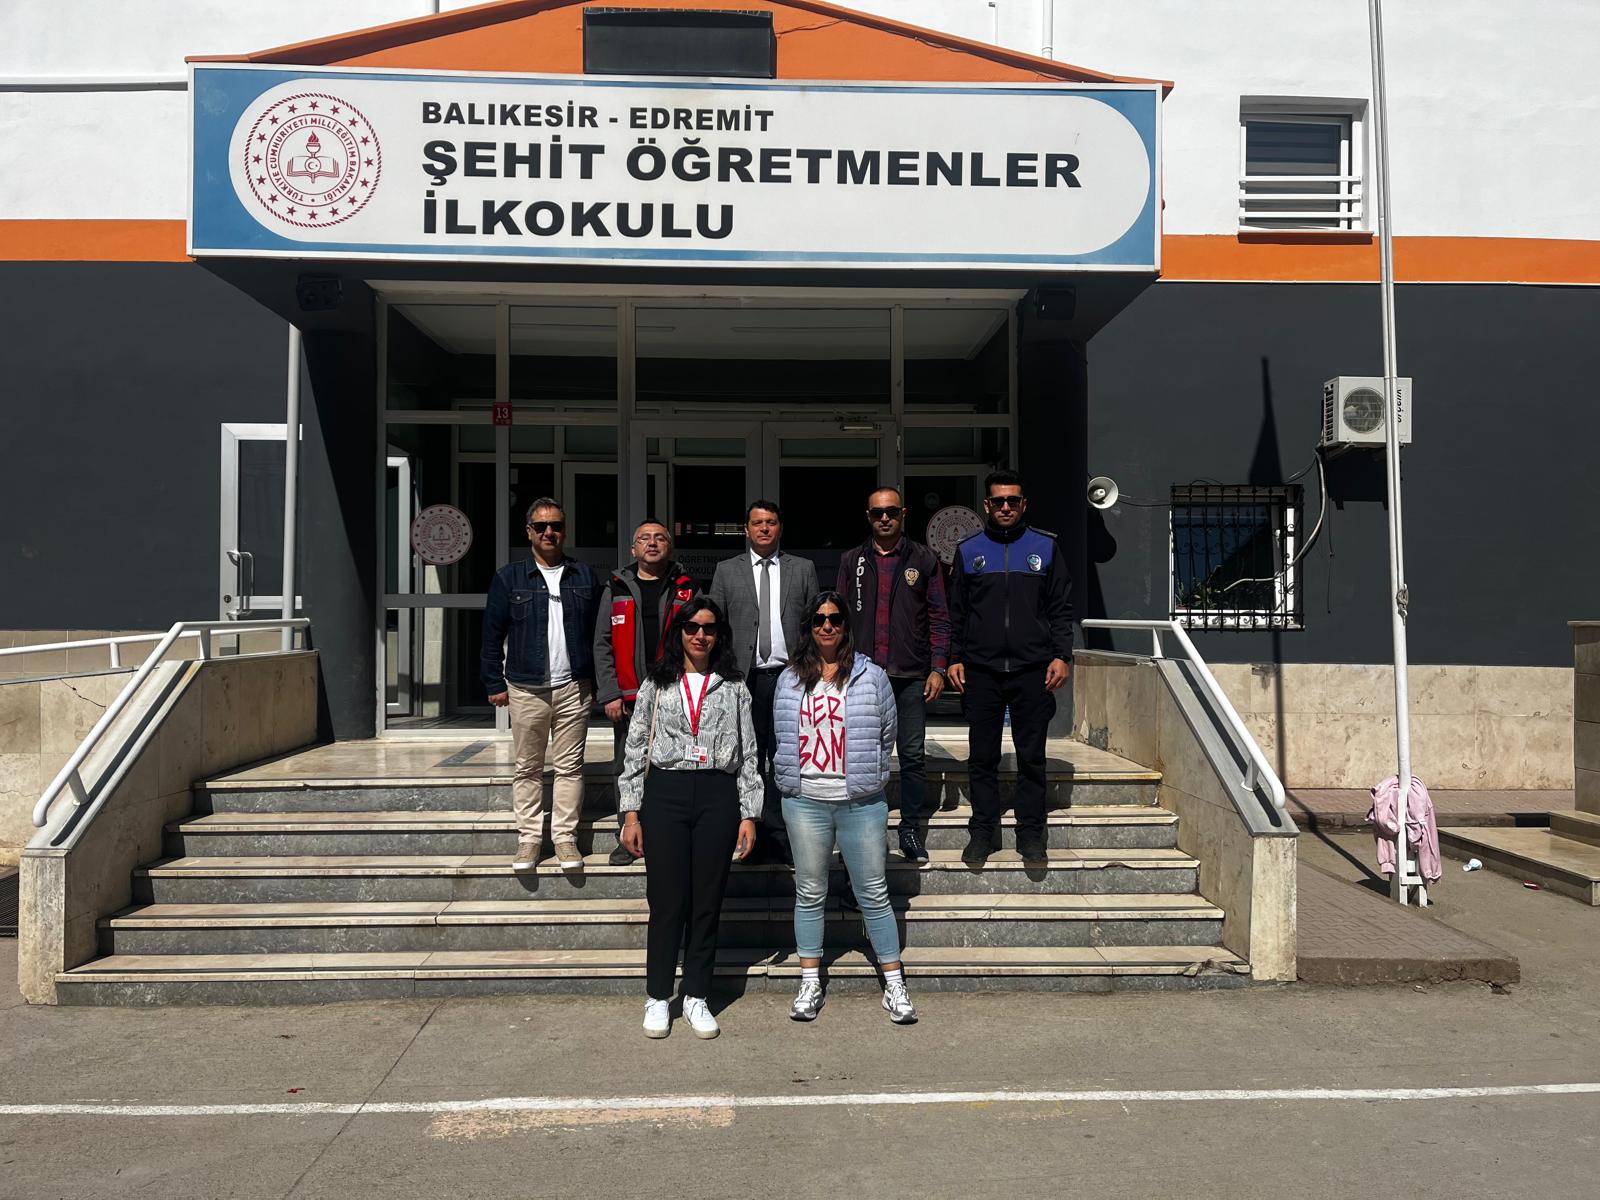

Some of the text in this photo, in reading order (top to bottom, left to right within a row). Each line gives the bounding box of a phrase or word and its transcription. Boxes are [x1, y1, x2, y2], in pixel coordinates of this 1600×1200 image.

[422, 100, 599, 128] BALIKESİR
[629, 104, 774, 131] EDREMİT
[269, 117, 357, 202] TÜRKİYE CUMHURİYETİ MİLLİ EĞİTİM BAKANLIĞI
[422, 135, 1081, 188] ŞEHİT ÖĞRETMENLER
[424, 190, 733, 239] İLKOKULU
[496, 407, 509, 419] 13
[800, 693, 848, 728] HER
